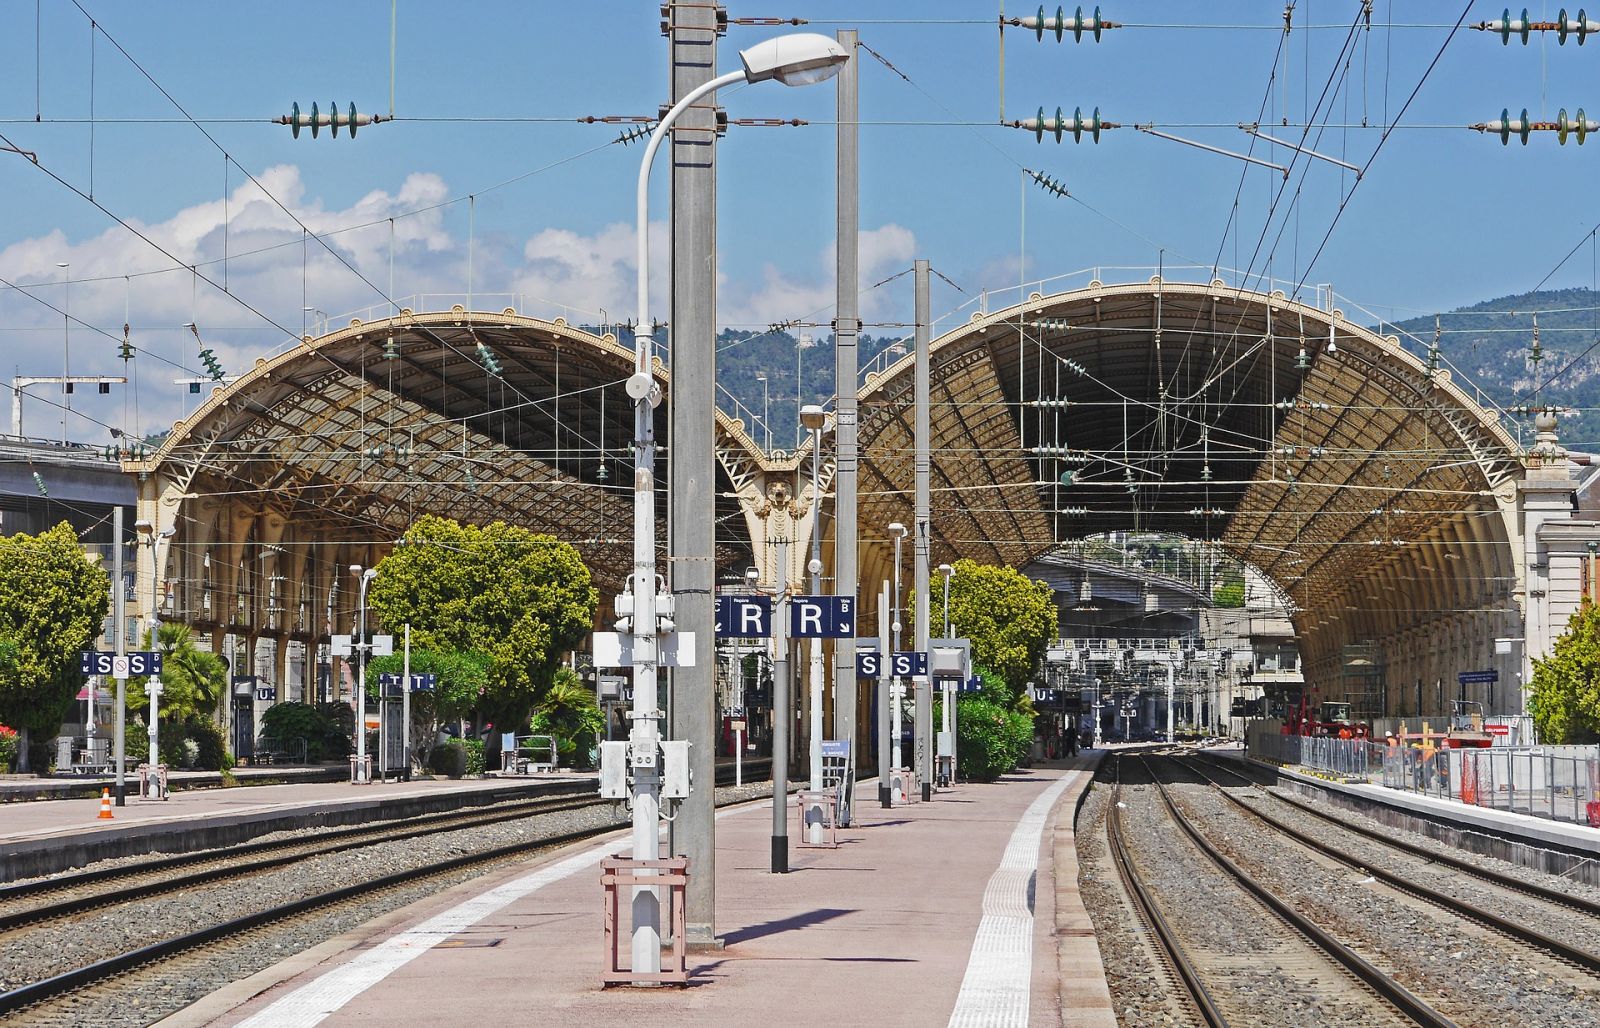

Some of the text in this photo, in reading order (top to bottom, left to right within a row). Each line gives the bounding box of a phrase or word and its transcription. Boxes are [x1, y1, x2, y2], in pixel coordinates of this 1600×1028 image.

[841, 604, 849, 612] B
[741, 604, 763, 633] R
[800, 604, 822, 633] R
[98, 655, 111, 673] S
[131, 655, 145, 673] S
[862, 656, 876, 674] S
[896, 656, 910, 674] S
[390, 676, 400, 685] T
[414, 676, 424, 688] T
[260, 690, 268, 699] U
[1037, 690, 1046, 700] U
